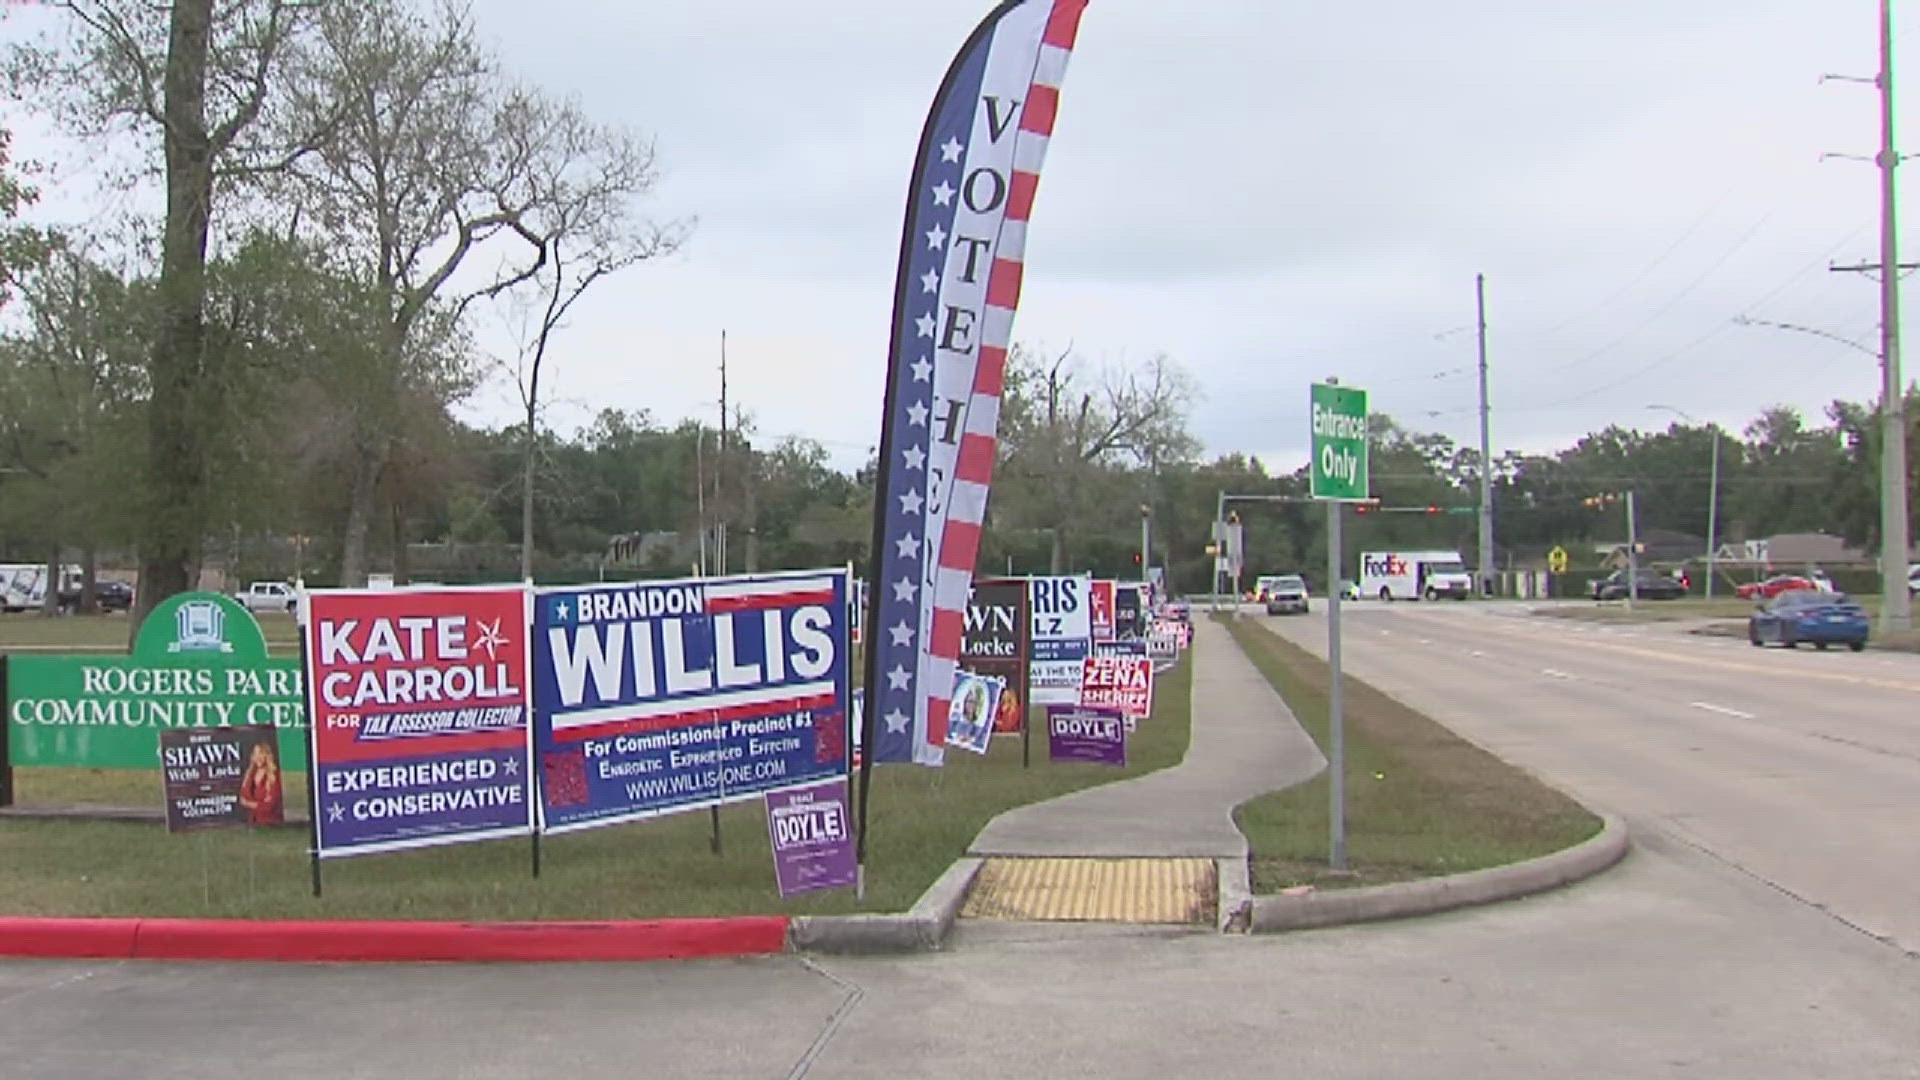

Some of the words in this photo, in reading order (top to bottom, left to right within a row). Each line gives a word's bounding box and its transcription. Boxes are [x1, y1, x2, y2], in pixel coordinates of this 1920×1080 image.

[937, 96, 1021, 355] VOTE
[1313, 403, 1365, 440] Entrance
[1321, 444, 1358, 486] Only
[1364, 554, 1408, 577] FedEx
[577, 586, 703, 622] BRANDON
[319, 615, 468, 666] KATE
[548, 604, 835, 707] WILLIS
[961, 636, 1015, 656] Locke
[82, 666, 213, 695] ROGERS
[322, 663, 520, 708] CARROLL
[1084, 667, 1147, 689] ZENA
[12, 699, 235, 728] COMMUNITY
[327, 713, 361, 730] FOR
[363, 714, 391, 734] TAX
[390, 710, 456, 732] ASSESSOR
[454, 706, 521, 727] COLLECTOR
[1056, 719, 1116, 741] DOYLE
[584, 740, 612, 758] For
[616, 724, 727, 755] Commissioner
[731, 715, 793, 738] Precinct
[165, 742, 241, 767] SHAWN
[168, 767, 200, 782] Webb
[207, 763, 241, 779] Locke
[327, 759, 497, 793] EXPERIENCED
[352, 784, 521, 820] CONSERVATIVE
[777, 809, 840, 844] DOYLE
